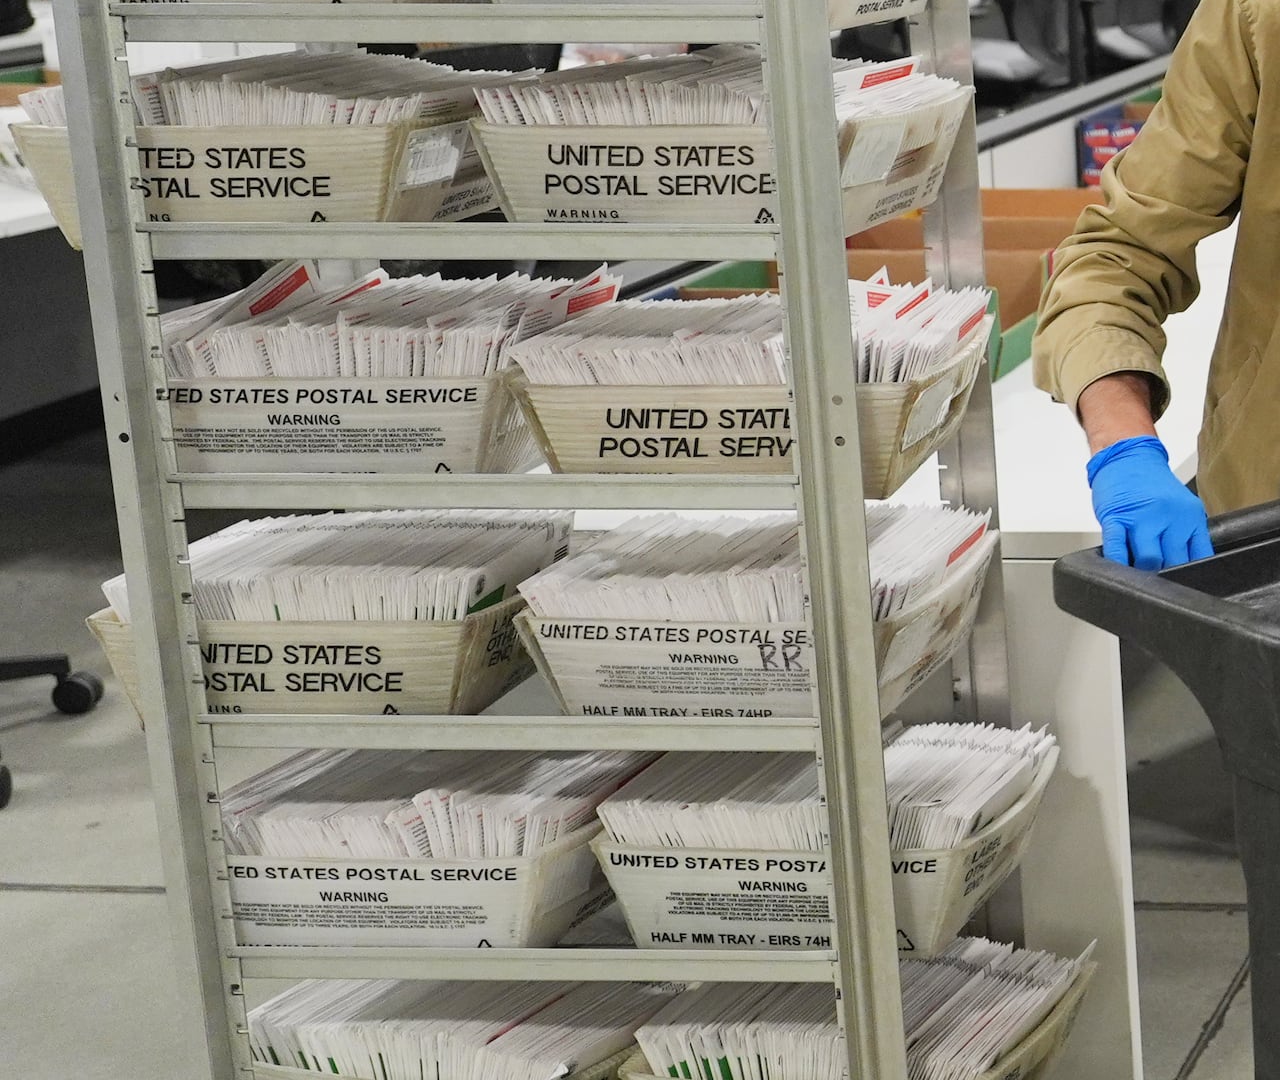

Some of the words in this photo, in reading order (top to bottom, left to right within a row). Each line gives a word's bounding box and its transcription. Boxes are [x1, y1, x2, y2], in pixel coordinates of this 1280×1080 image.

[138, 148, 194, 168] TED
[205, 148, 305, 168] STATES
[548, 144, 643, 166] UNITED
[654, 146, 754, 166] STATES
[210, 177, 330, 197] SERVICE
[546, 174, 648, 195] POSTAL
[658, 174, 774, 195] SERVICE
[548, 210, 618, 218] WARNING
[210, 389, 288, 403] STATES
[296, 390, 378, 403] POSTAL
[386, 388, 476, 403] SERVICE
[268, 415, 340, 425] WARNING
[607, 409, 707, 428] UNITED
[718, 408, 790, 428] STATE
[600, 438, 708, 457] POSTAL
[720, 437, 793, 456] SERV
[541, 624, 608, 640] UNITED
[616, 627, 689, 642] STATES
[697, 629, 774, 644] POSTAL
[284, 645, 381, 665] STATES
[669, 654, 738, 664] WARNING
[286, 672, 403, 692] SERVICE
[621, 706, 645, 716] MM
[649, 706, 688, 716] TRAY
[611, 853, 678, 868] UNITED
[686, 858, 759, 870] STATES
[766, 860, 826, 872] POSTA
[266, 868, 339, 880] STATES
[347, 869, 424, 880] POSTAL
[431, 868, 516, 880] SERVICE
[738, 881, 807, 892] WARNING
[320, 892, 388, 902] WARNING
[652, 932, 686, 942] HALF
[692, 934, 714, 943] MM
[718, 934, 755, 944] TRAY
[769, 936, 800, 945] EIRS
[805, 936, 830, 946] 74H
